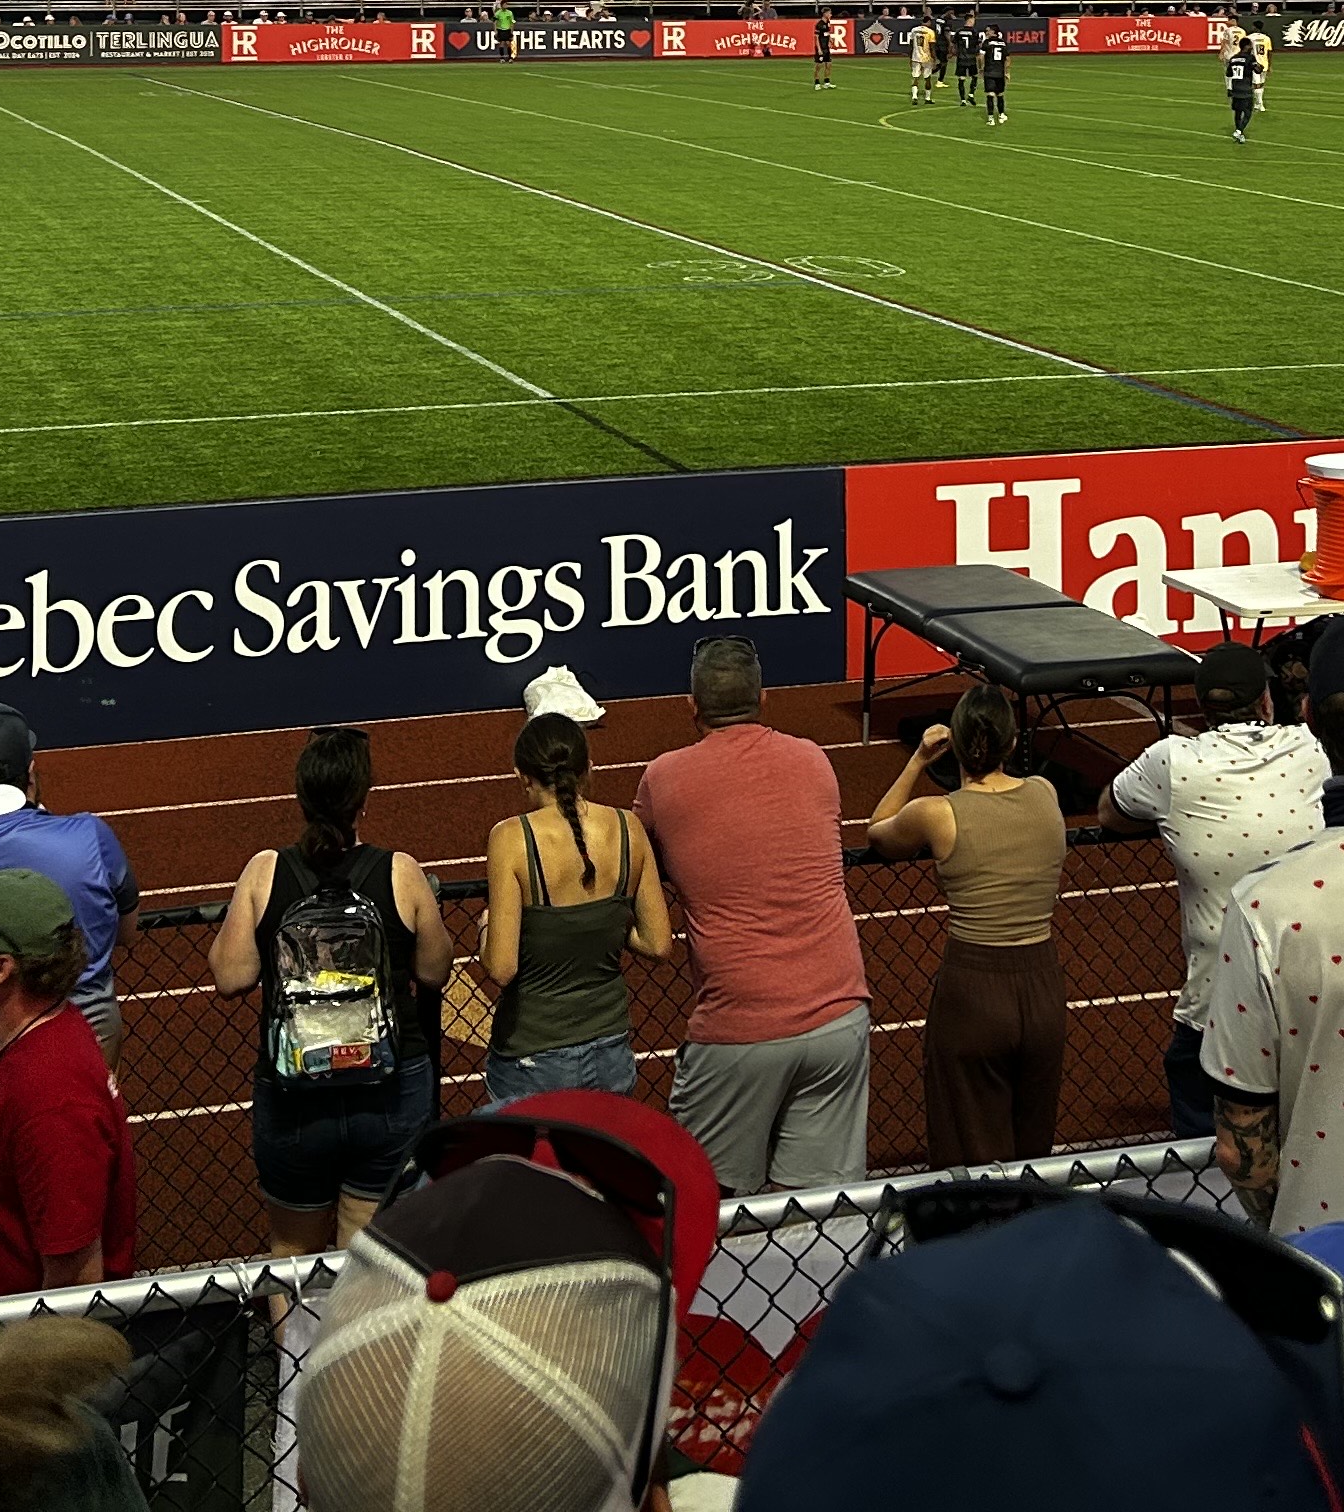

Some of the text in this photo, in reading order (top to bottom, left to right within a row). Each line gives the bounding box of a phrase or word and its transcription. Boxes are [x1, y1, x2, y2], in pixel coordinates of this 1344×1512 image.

[324, 25, 345, 35] THE
[746, 21, 764, 31] THE
[1135, 18, 1153, 28] THE
[95, 30, 220, 49] TERLINGUA
[513, 30, 547, 49] THE
[553, 29, 626, 50] HEARTS
[1007, 30, 1046, 44] HEART
[1105, 29, 1183, 47] HIGHROLLER
[289, 37, 382, 56] HIGHROLLER
[233, 548, 586, 664] Savings
[600, 518, 832, 629] Bank
